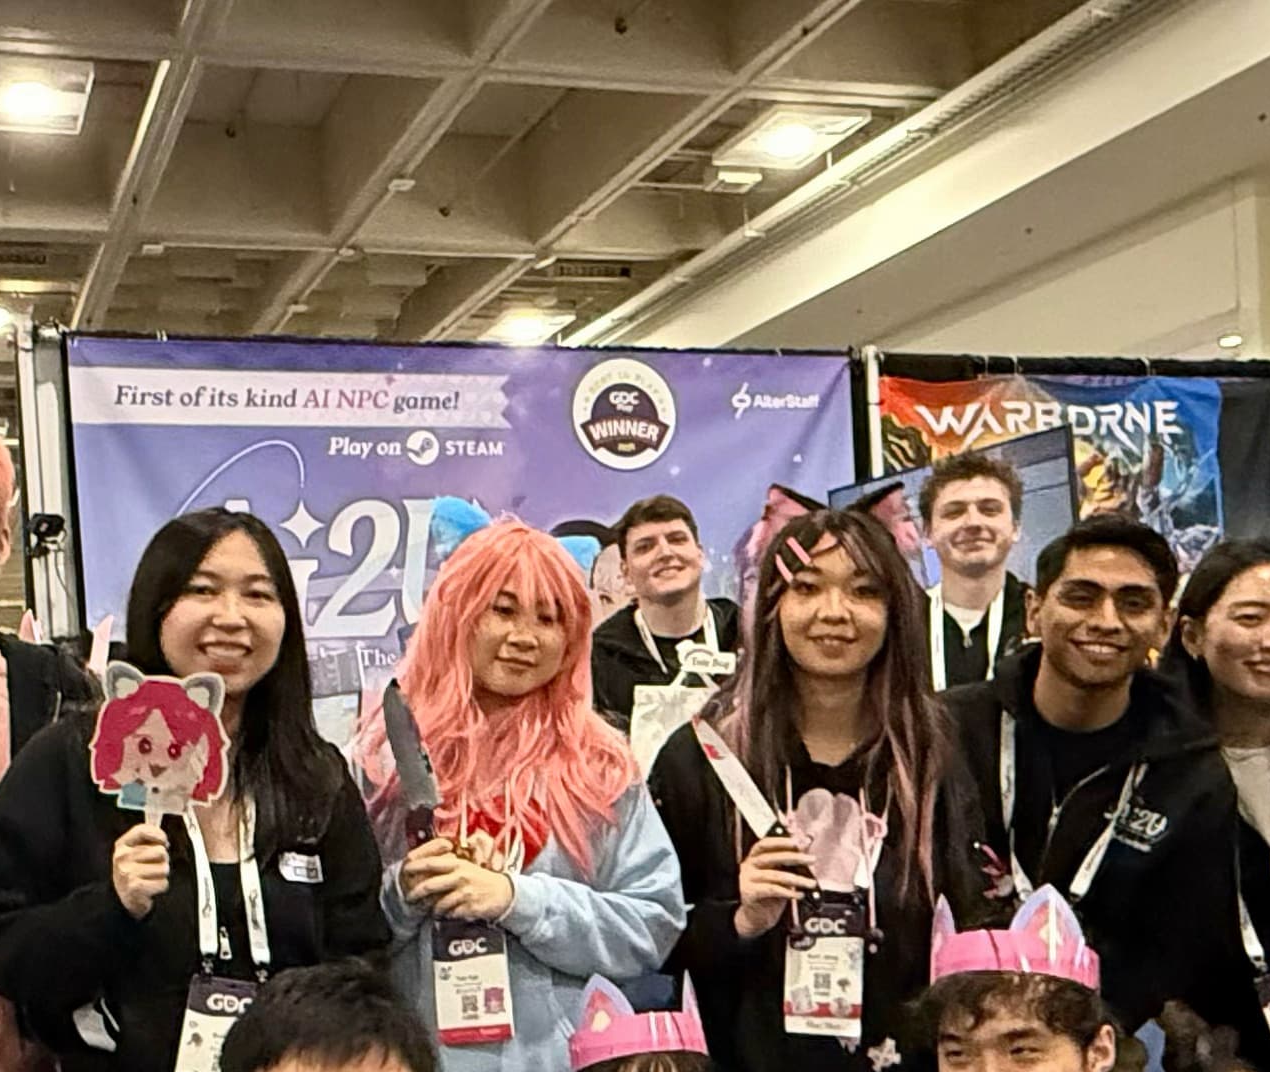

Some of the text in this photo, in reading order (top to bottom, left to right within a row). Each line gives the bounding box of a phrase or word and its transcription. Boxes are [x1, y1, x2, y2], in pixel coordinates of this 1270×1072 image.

[115, 384, 461, 415] First of its kind AI NPC game!
[608, 390, 641, 406] GDC
[588, 418, 660, 442] WINNER
[328, 435, 504, 458] Play on STEAM
[360, 650, 398, 668] The
[803, 916, 847, 934] GDC
[448, 936, 488, 956] GDC
